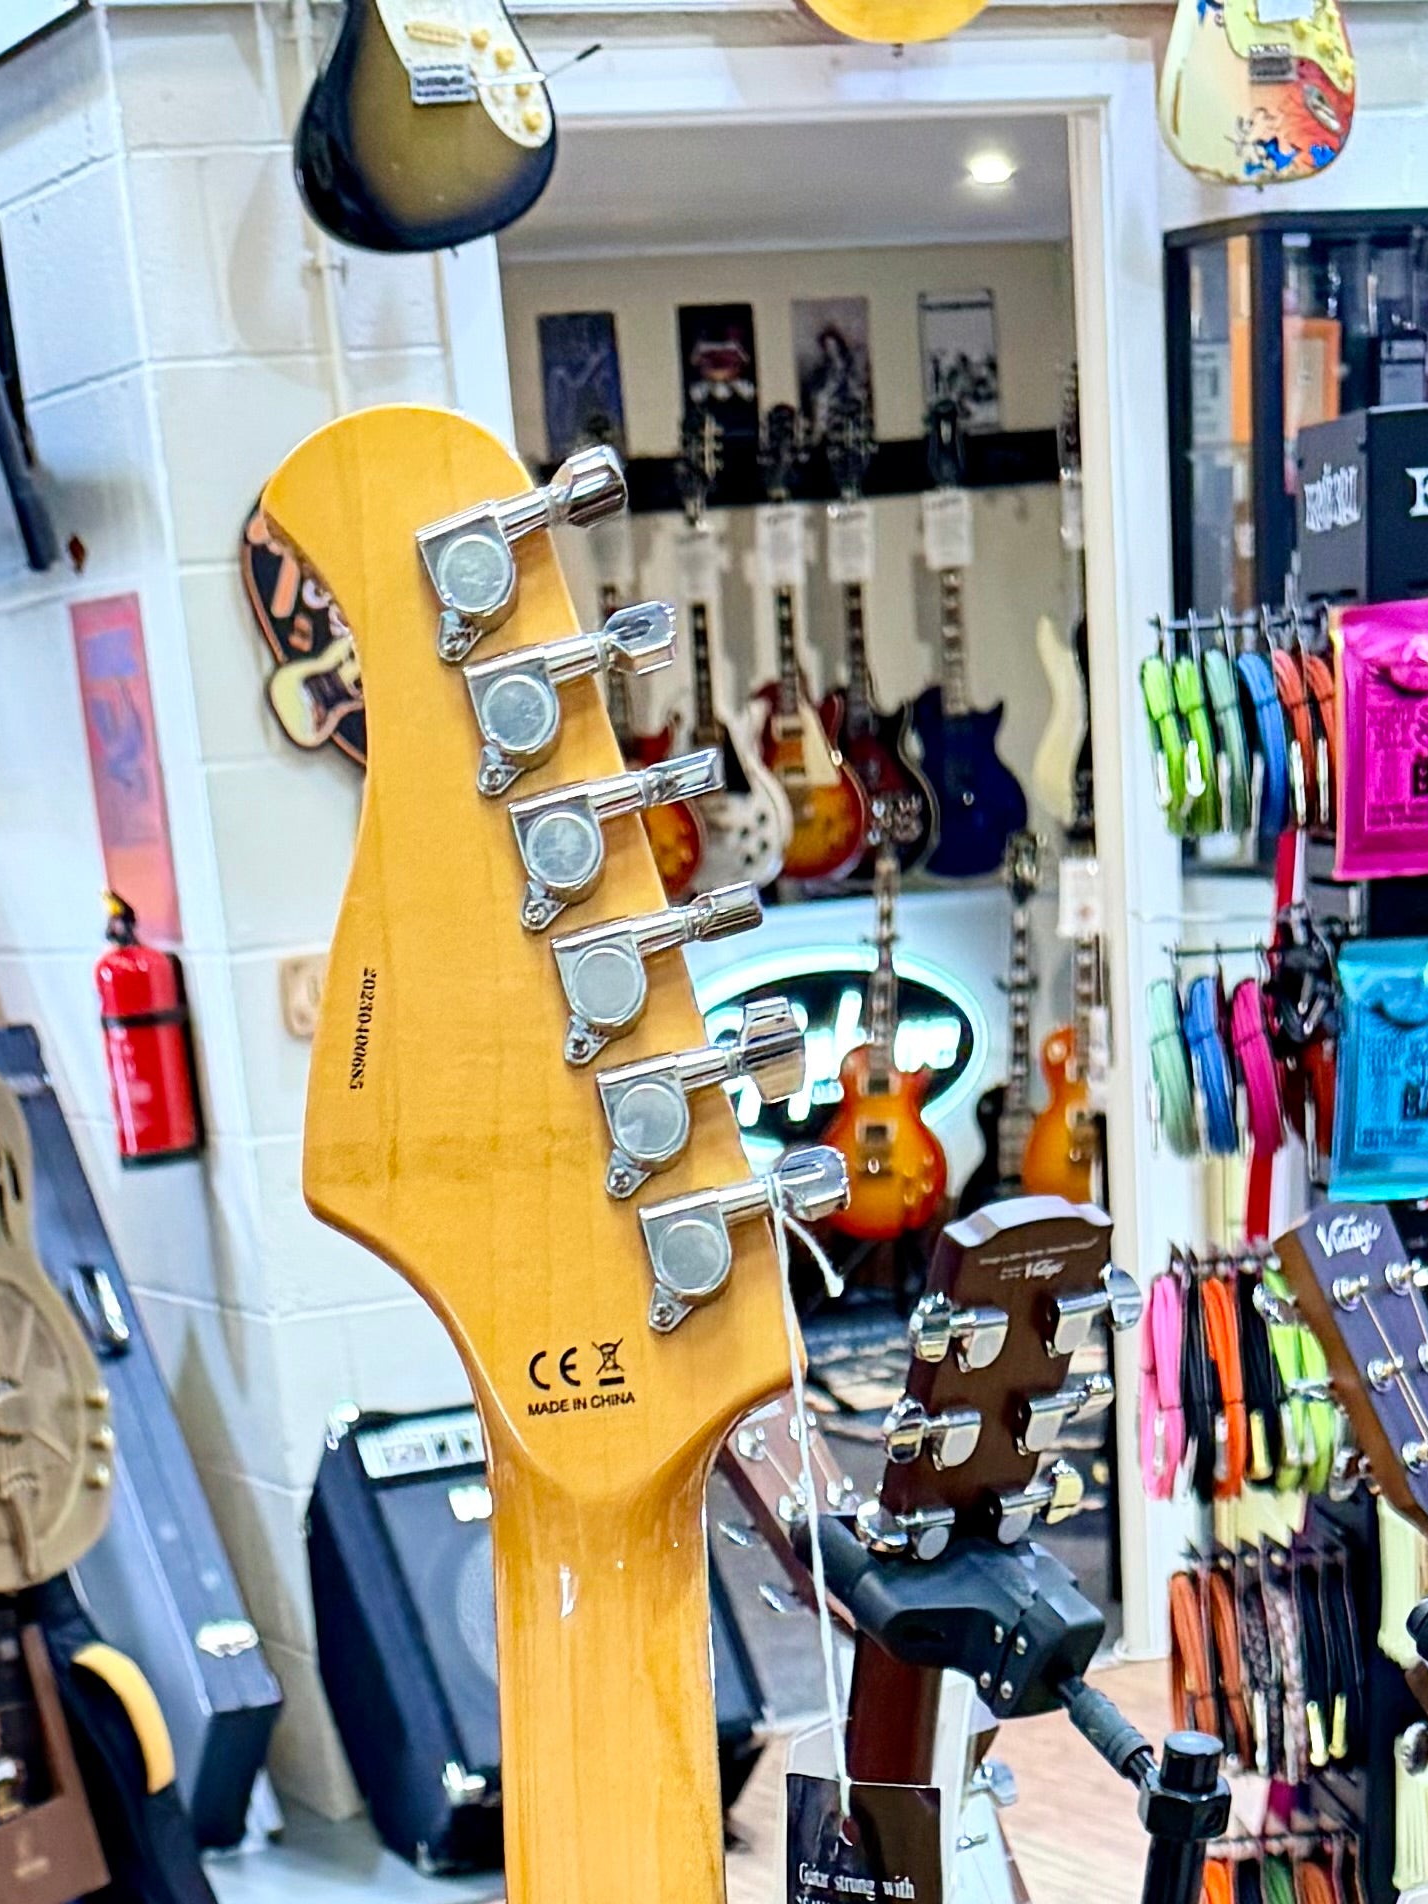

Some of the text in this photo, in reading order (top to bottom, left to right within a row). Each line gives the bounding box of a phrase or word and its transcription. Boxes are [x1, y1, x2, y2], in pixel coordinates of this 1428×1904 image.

[528, 1391, 636, 1416] MADE IN CHINA
[833, 1873, 876, 1901] strung
[883, 1875, 915, 1900] with
